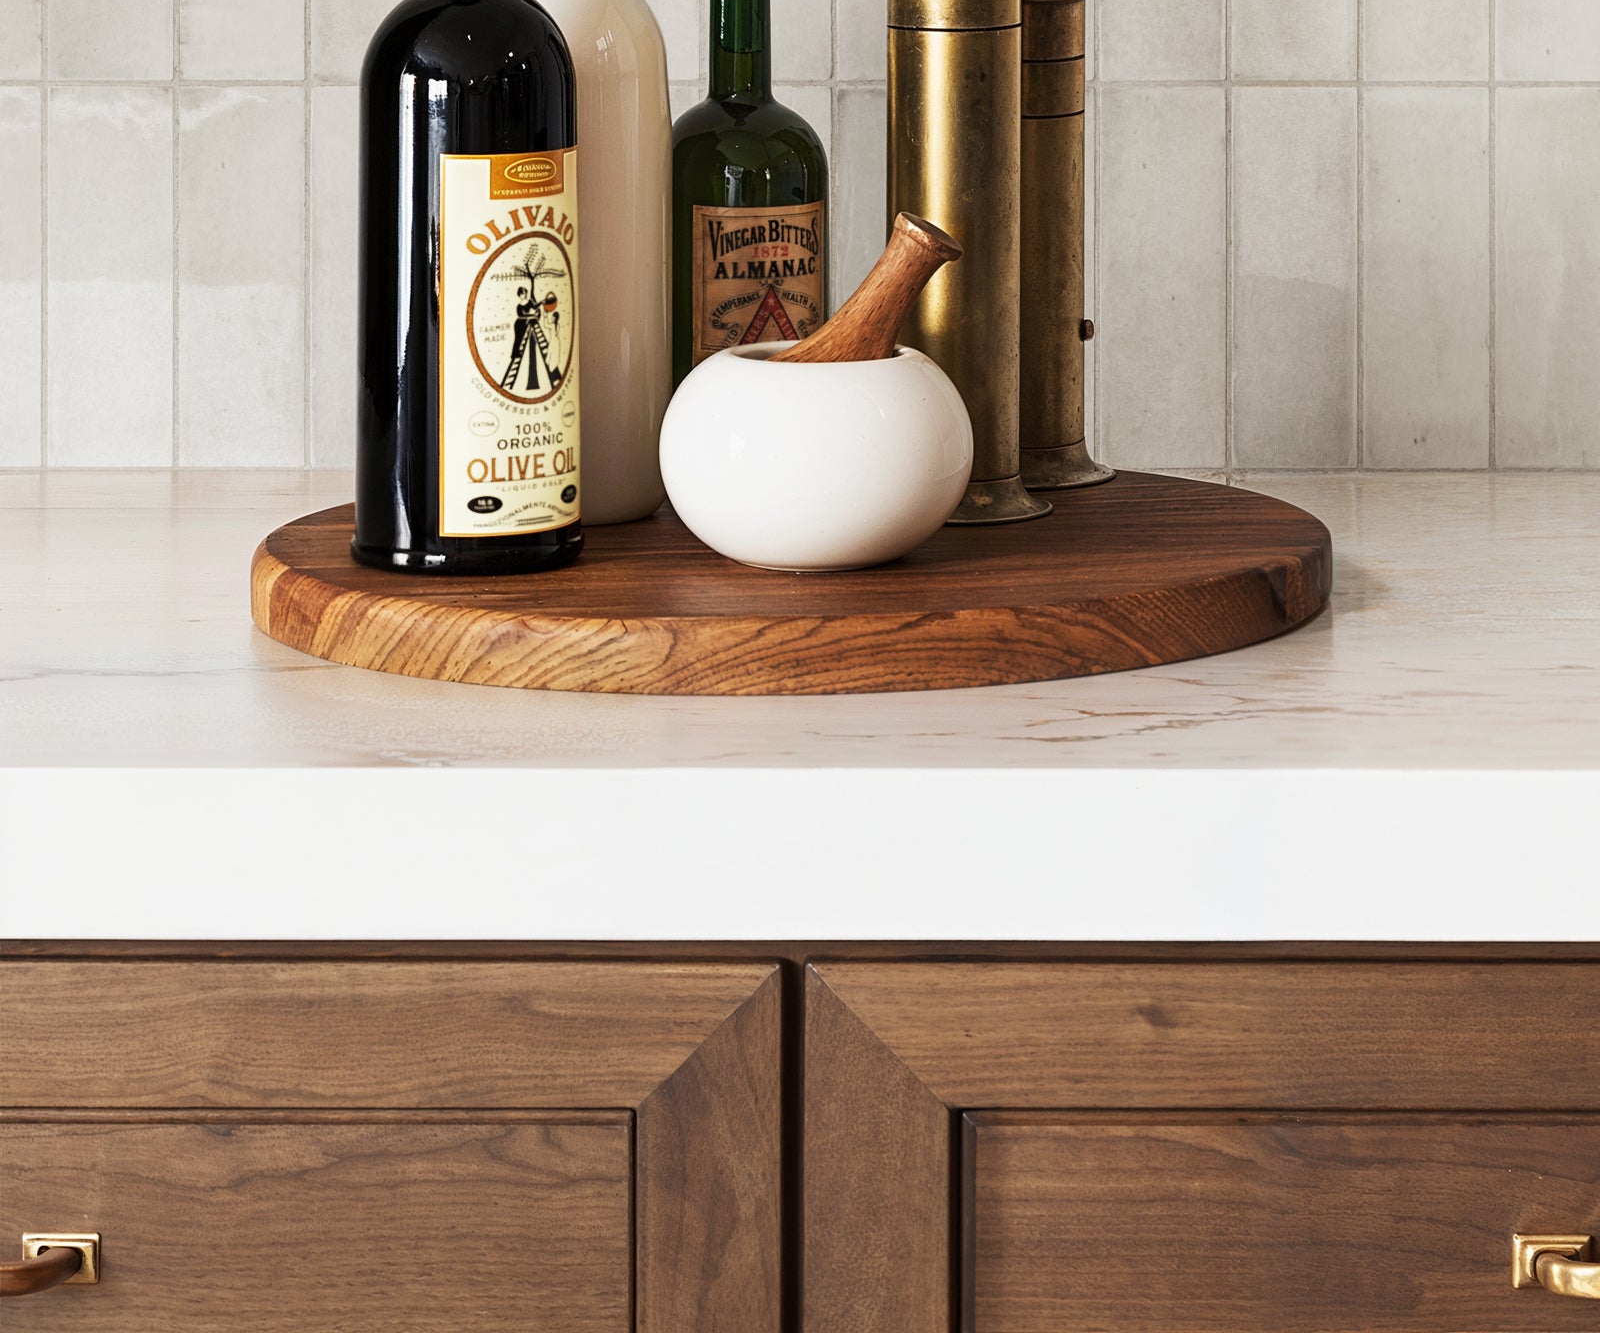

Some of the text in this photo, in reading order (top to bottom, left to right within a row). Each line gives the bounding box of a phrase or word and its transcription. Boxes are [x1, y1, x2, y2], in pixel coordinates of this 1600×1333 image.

[466, 204, 575, 255] OLIVAIO
[752, 245, 789, 258] 1872
[781, 290, 808, 306] HEALTH
[479, 322, 512, 334] FARMER
[484, 334, 507, 344] MADE
[471, 377, 493, 400] COLD
[492, 396, 541, 415] PRESSED
[514, 421, 553, 436] 100%
[497, 432, 564, 451] ORGANIC
[467, 446, 577, 484] OLIVE OIL
